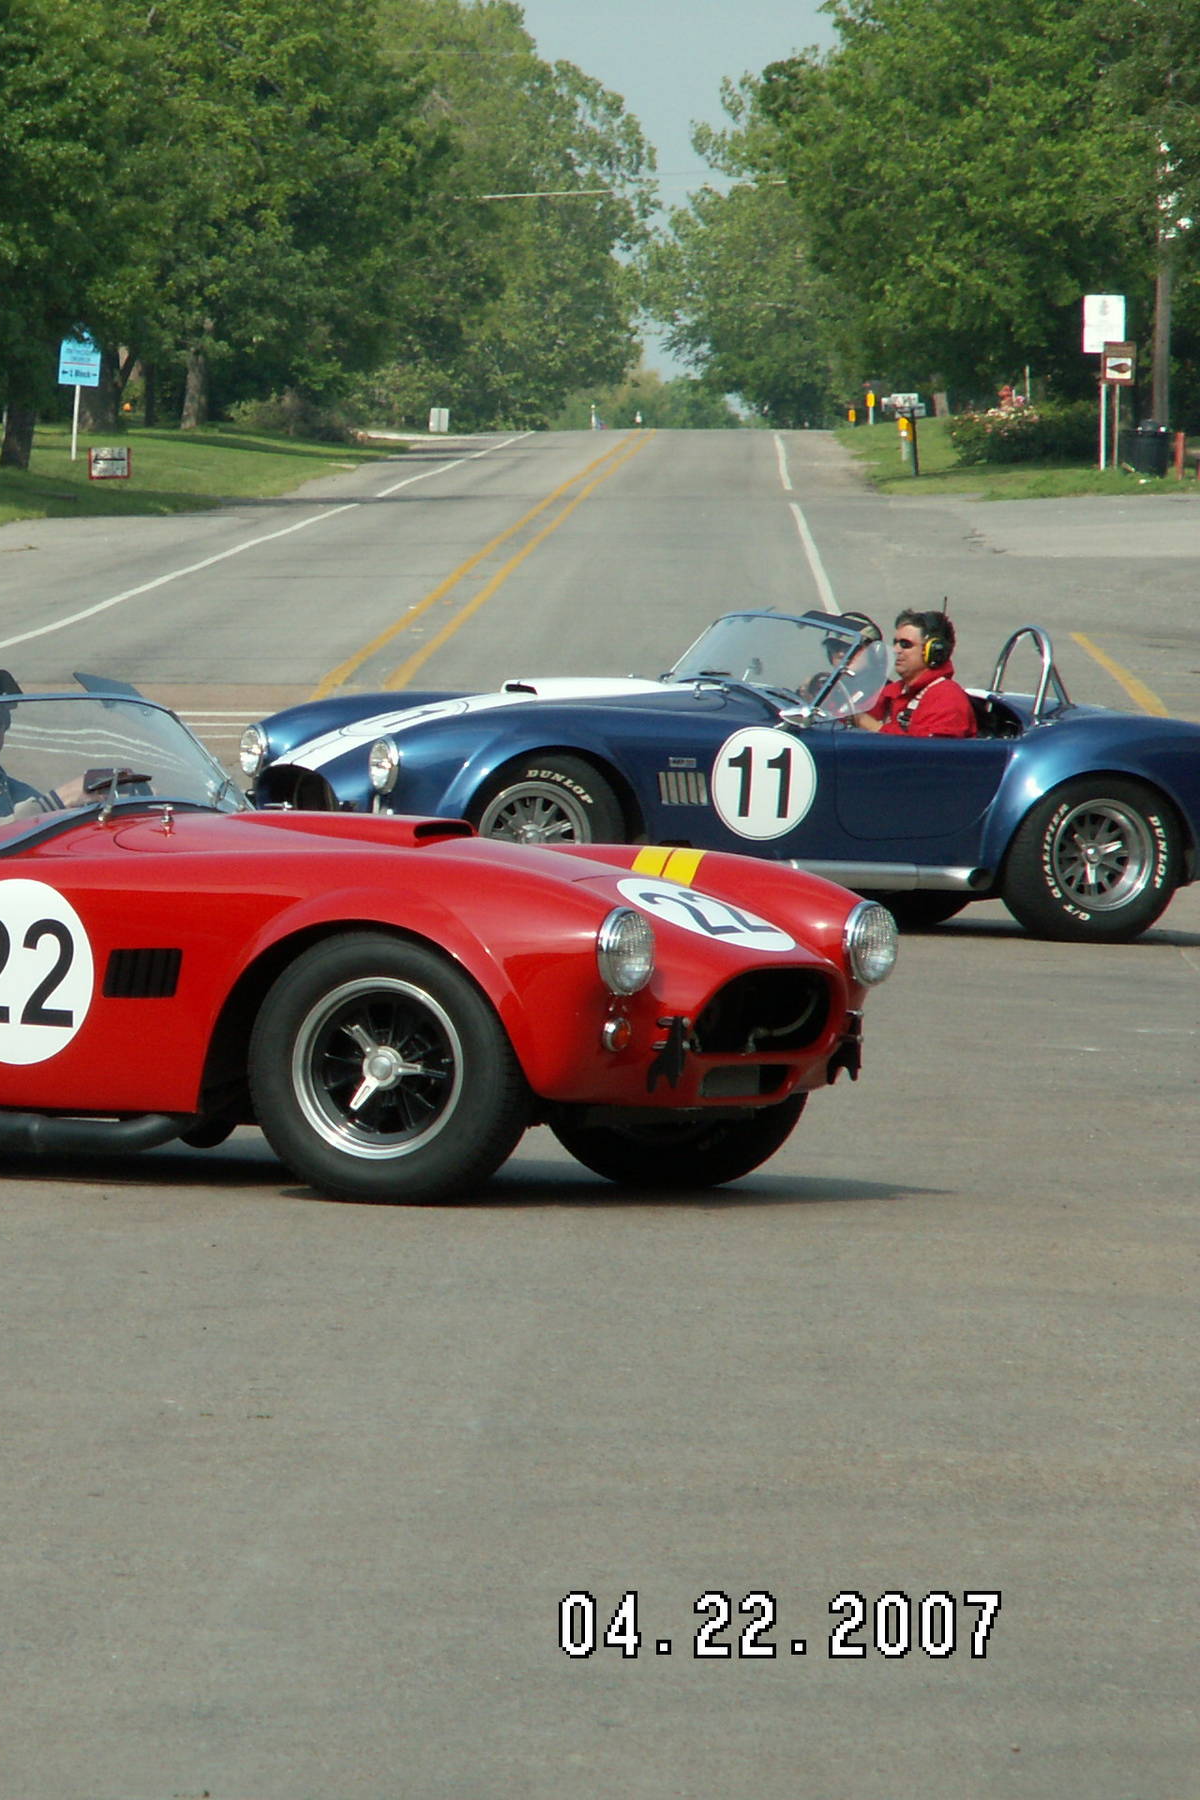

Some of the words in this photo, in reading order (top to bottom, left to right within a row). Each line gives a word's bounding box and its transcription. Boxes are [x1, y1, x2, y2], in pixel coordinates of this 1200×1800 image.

[526, 769, 594, 804] DUNLOP
[728, 746, 792, 819] 11
[1148, 815, 1169, 889] DUNLOP
[638, 891, 784, 936] 22
